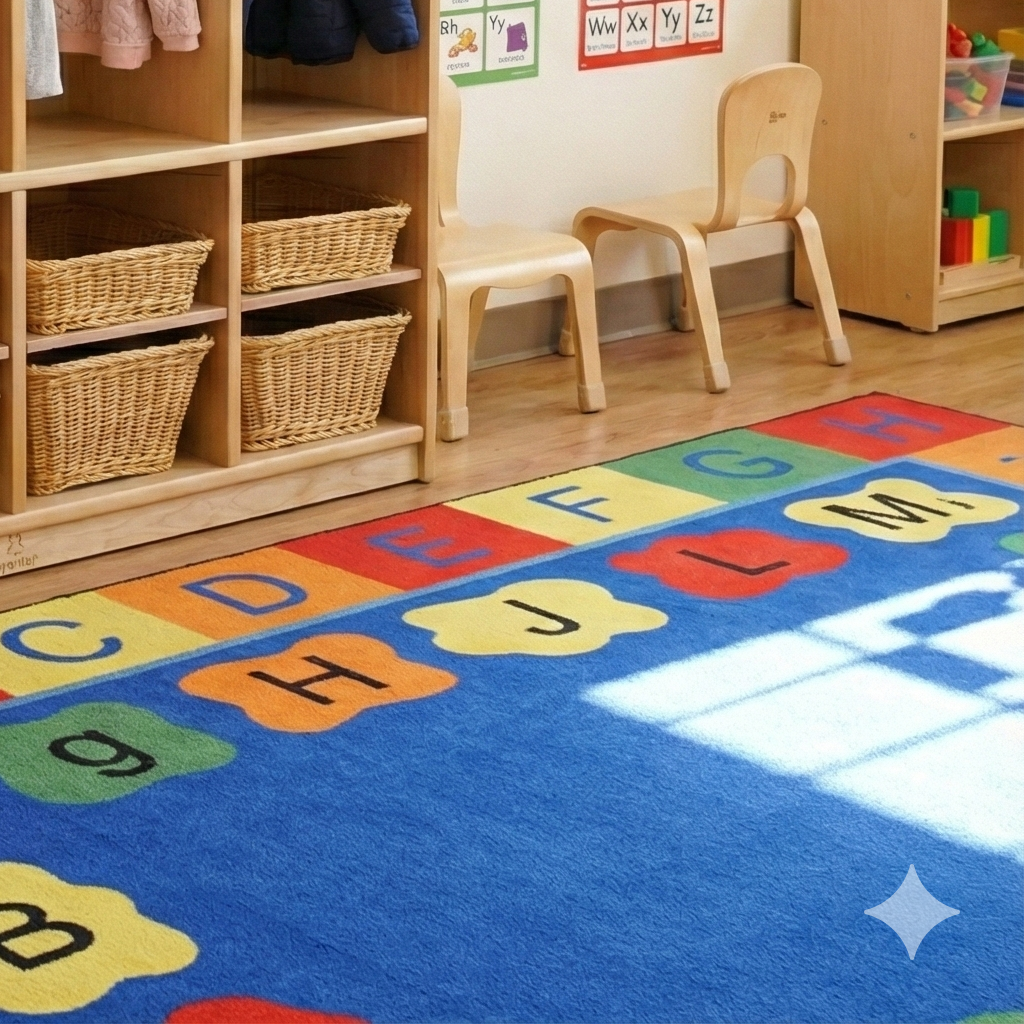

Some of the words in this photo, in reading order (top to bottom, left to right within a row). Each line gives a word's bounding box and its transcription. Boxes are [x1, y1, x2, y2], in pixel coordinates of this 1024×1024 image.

[489, 15, 505, 34] Yy
[588, 15, 617, 36] Ww
[626, 11, 648, 33] Xx
[661, 7, 681, 34] Yy
[695, 3, 714, 24] Zz
[820, 407, 944, 444] H
[683, 450, 794, 479] G
[526, 486, 613, 523] F
[365, 525, 492, 567] E
[676, 549, 792, 576] L
[179, 573, 308, 616] D
[502, 599, 581, 636] J
[0, 620, 124, 664] C
[247, 655, 392, 705] H
